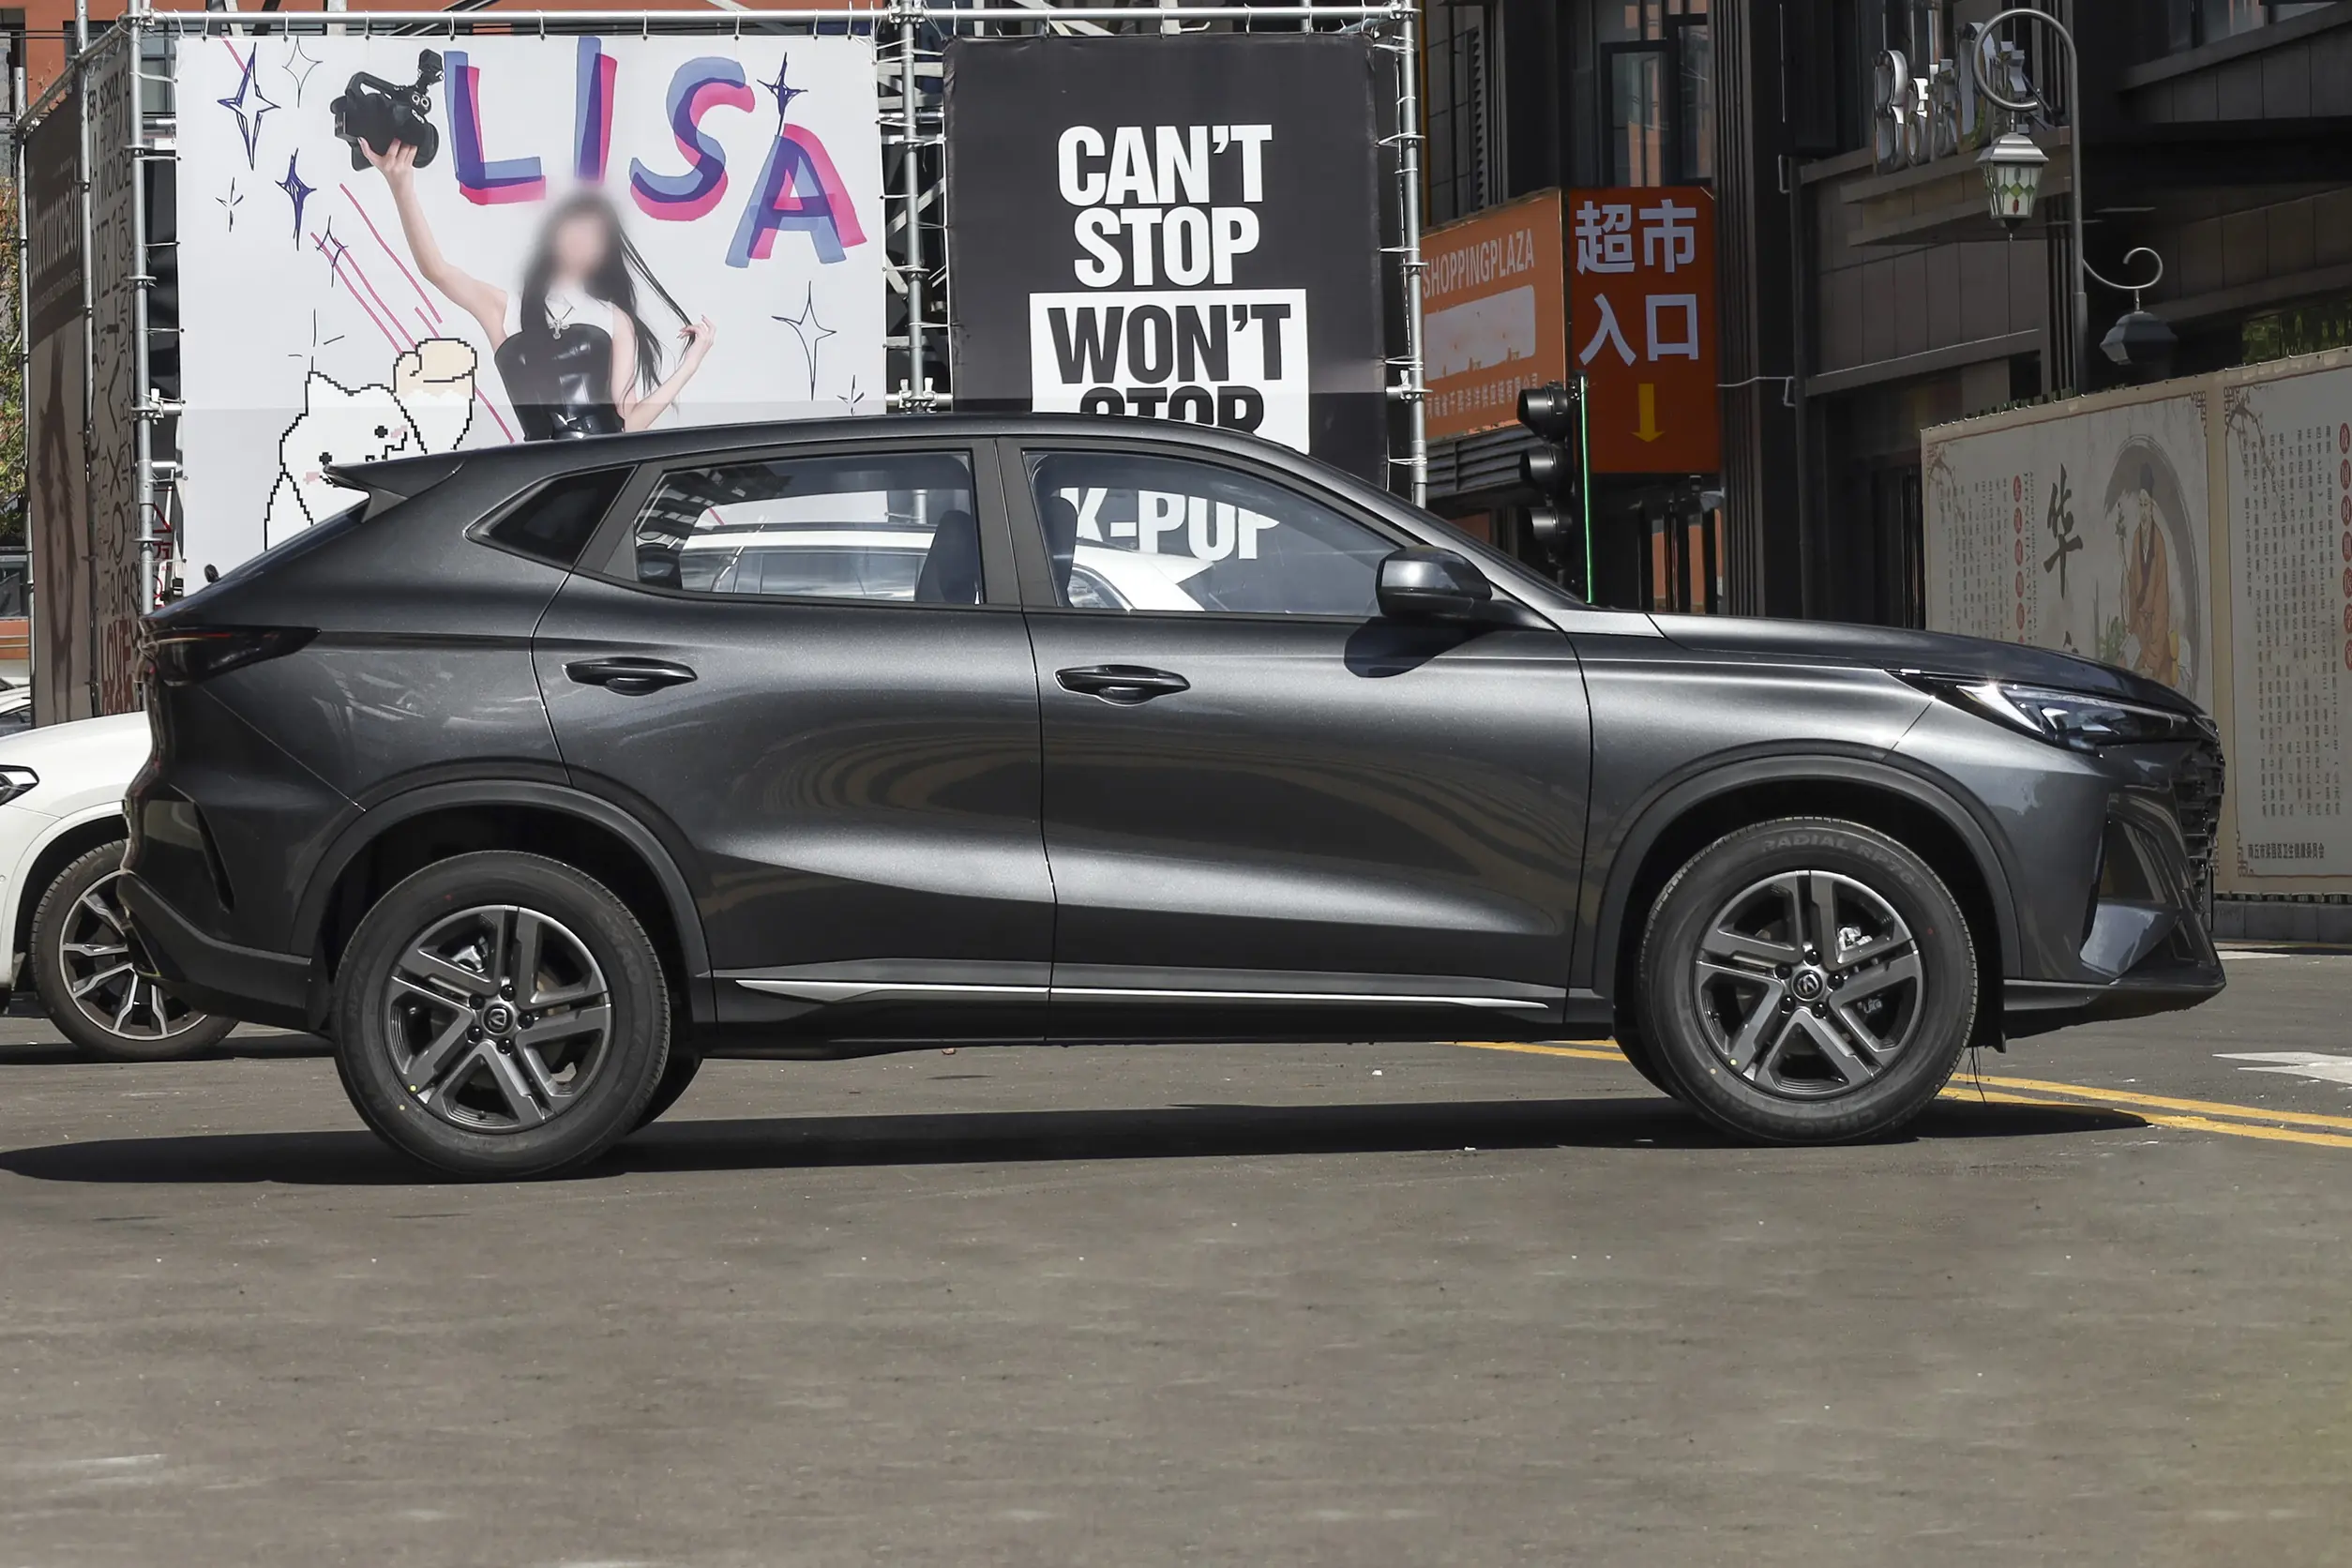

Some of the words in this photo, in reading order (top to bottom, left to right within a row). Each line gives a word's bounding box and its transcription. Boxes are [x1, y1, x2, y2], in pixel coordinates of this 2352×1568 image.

[445, 37, 867, 268] LISA
[1057, 124, 1273, 207] CAN'T
[1074, 206, 1260, 288] STOP
[1575, 198, 1697, 276] 超市
[1048, 303, 1291, 384] WON'T
[1578, 293, 1699, 367] 入口
